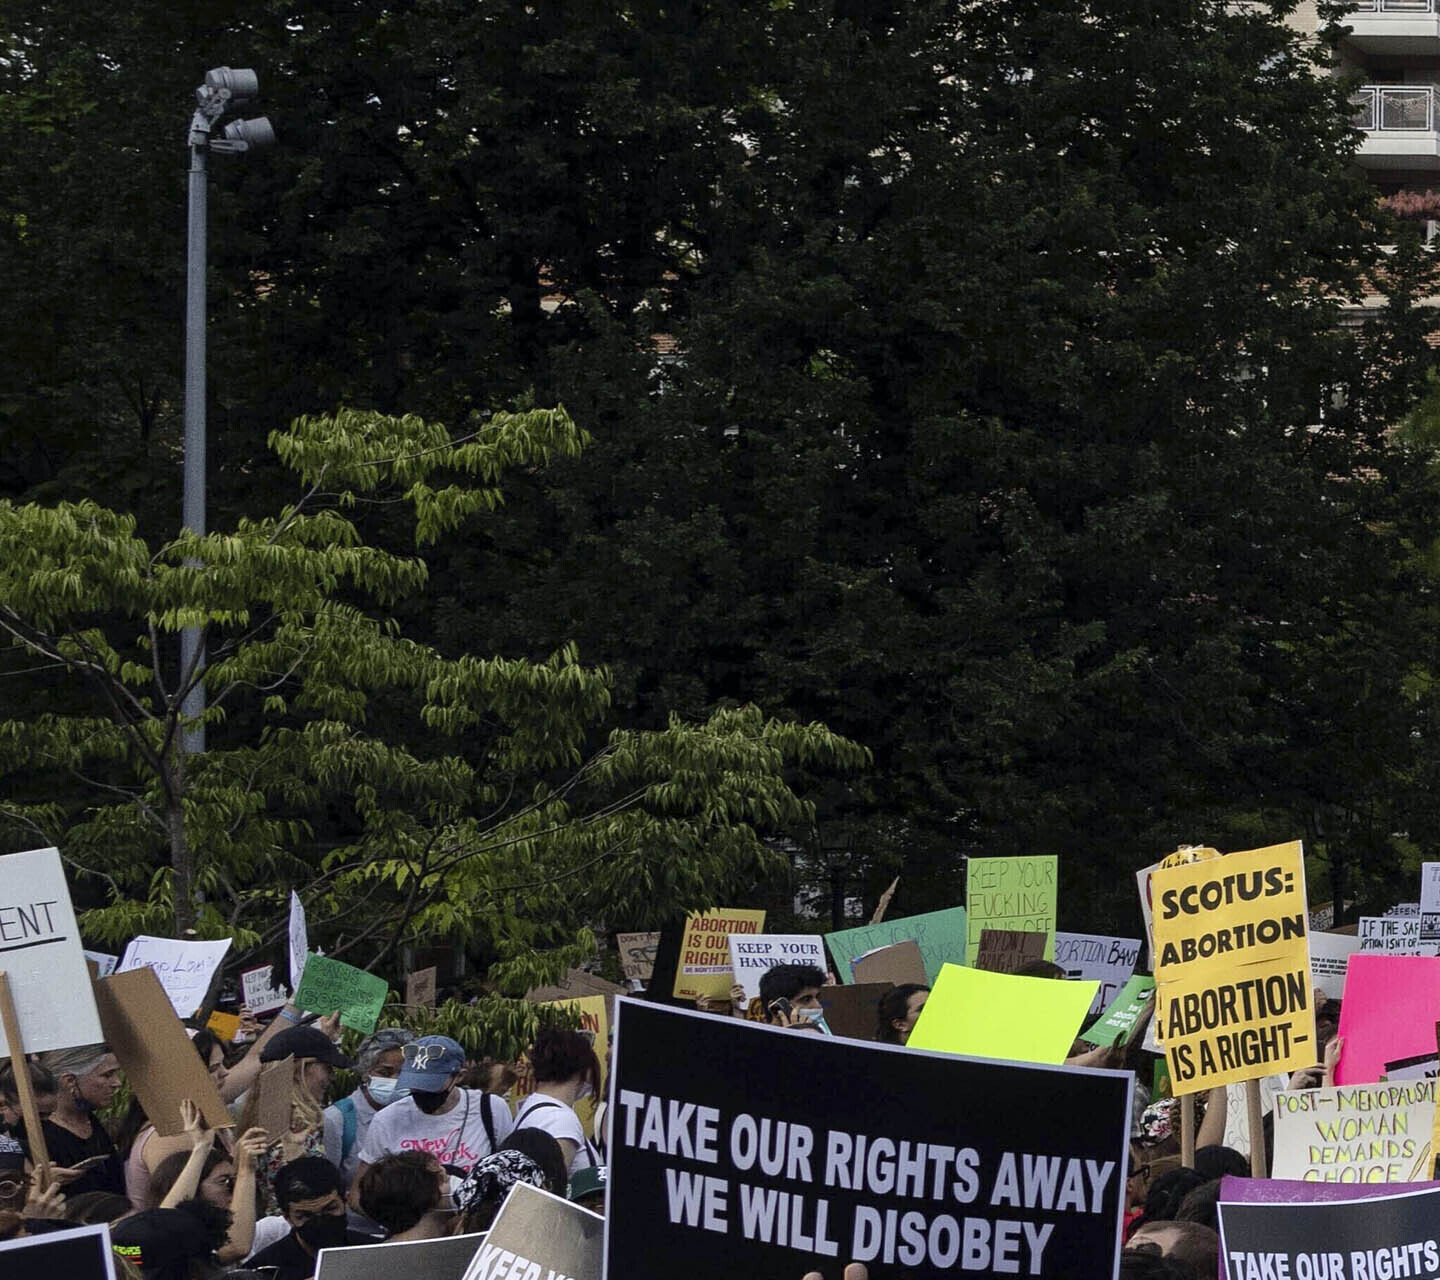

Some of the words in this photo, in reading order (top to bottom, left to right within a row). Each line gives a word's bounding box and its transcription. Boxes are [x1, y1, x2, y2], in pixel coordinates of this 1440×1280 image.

[1162, 867, 1294, 919] SCOTUS:
[1160, 914, 1305, 967] ABORTION
[1168, 971, 1306, 1039] ABORTION
[1172, 1044, 1195, 1082] IS
[1201, 1040, 1217, 1075] A
[620, 1089, 720, 1163] TAKE
[731, 1113, 813, 1183] OUR
[825, 1130, 980, 1203] RIGHTS
[990, 1152, 1116, 1213] AWAY
[666, 1168, 728, 1234] WE
[740, 1184, 838, 1257] WILL
[852, 1205, 1055, 1275] DISOBEY
